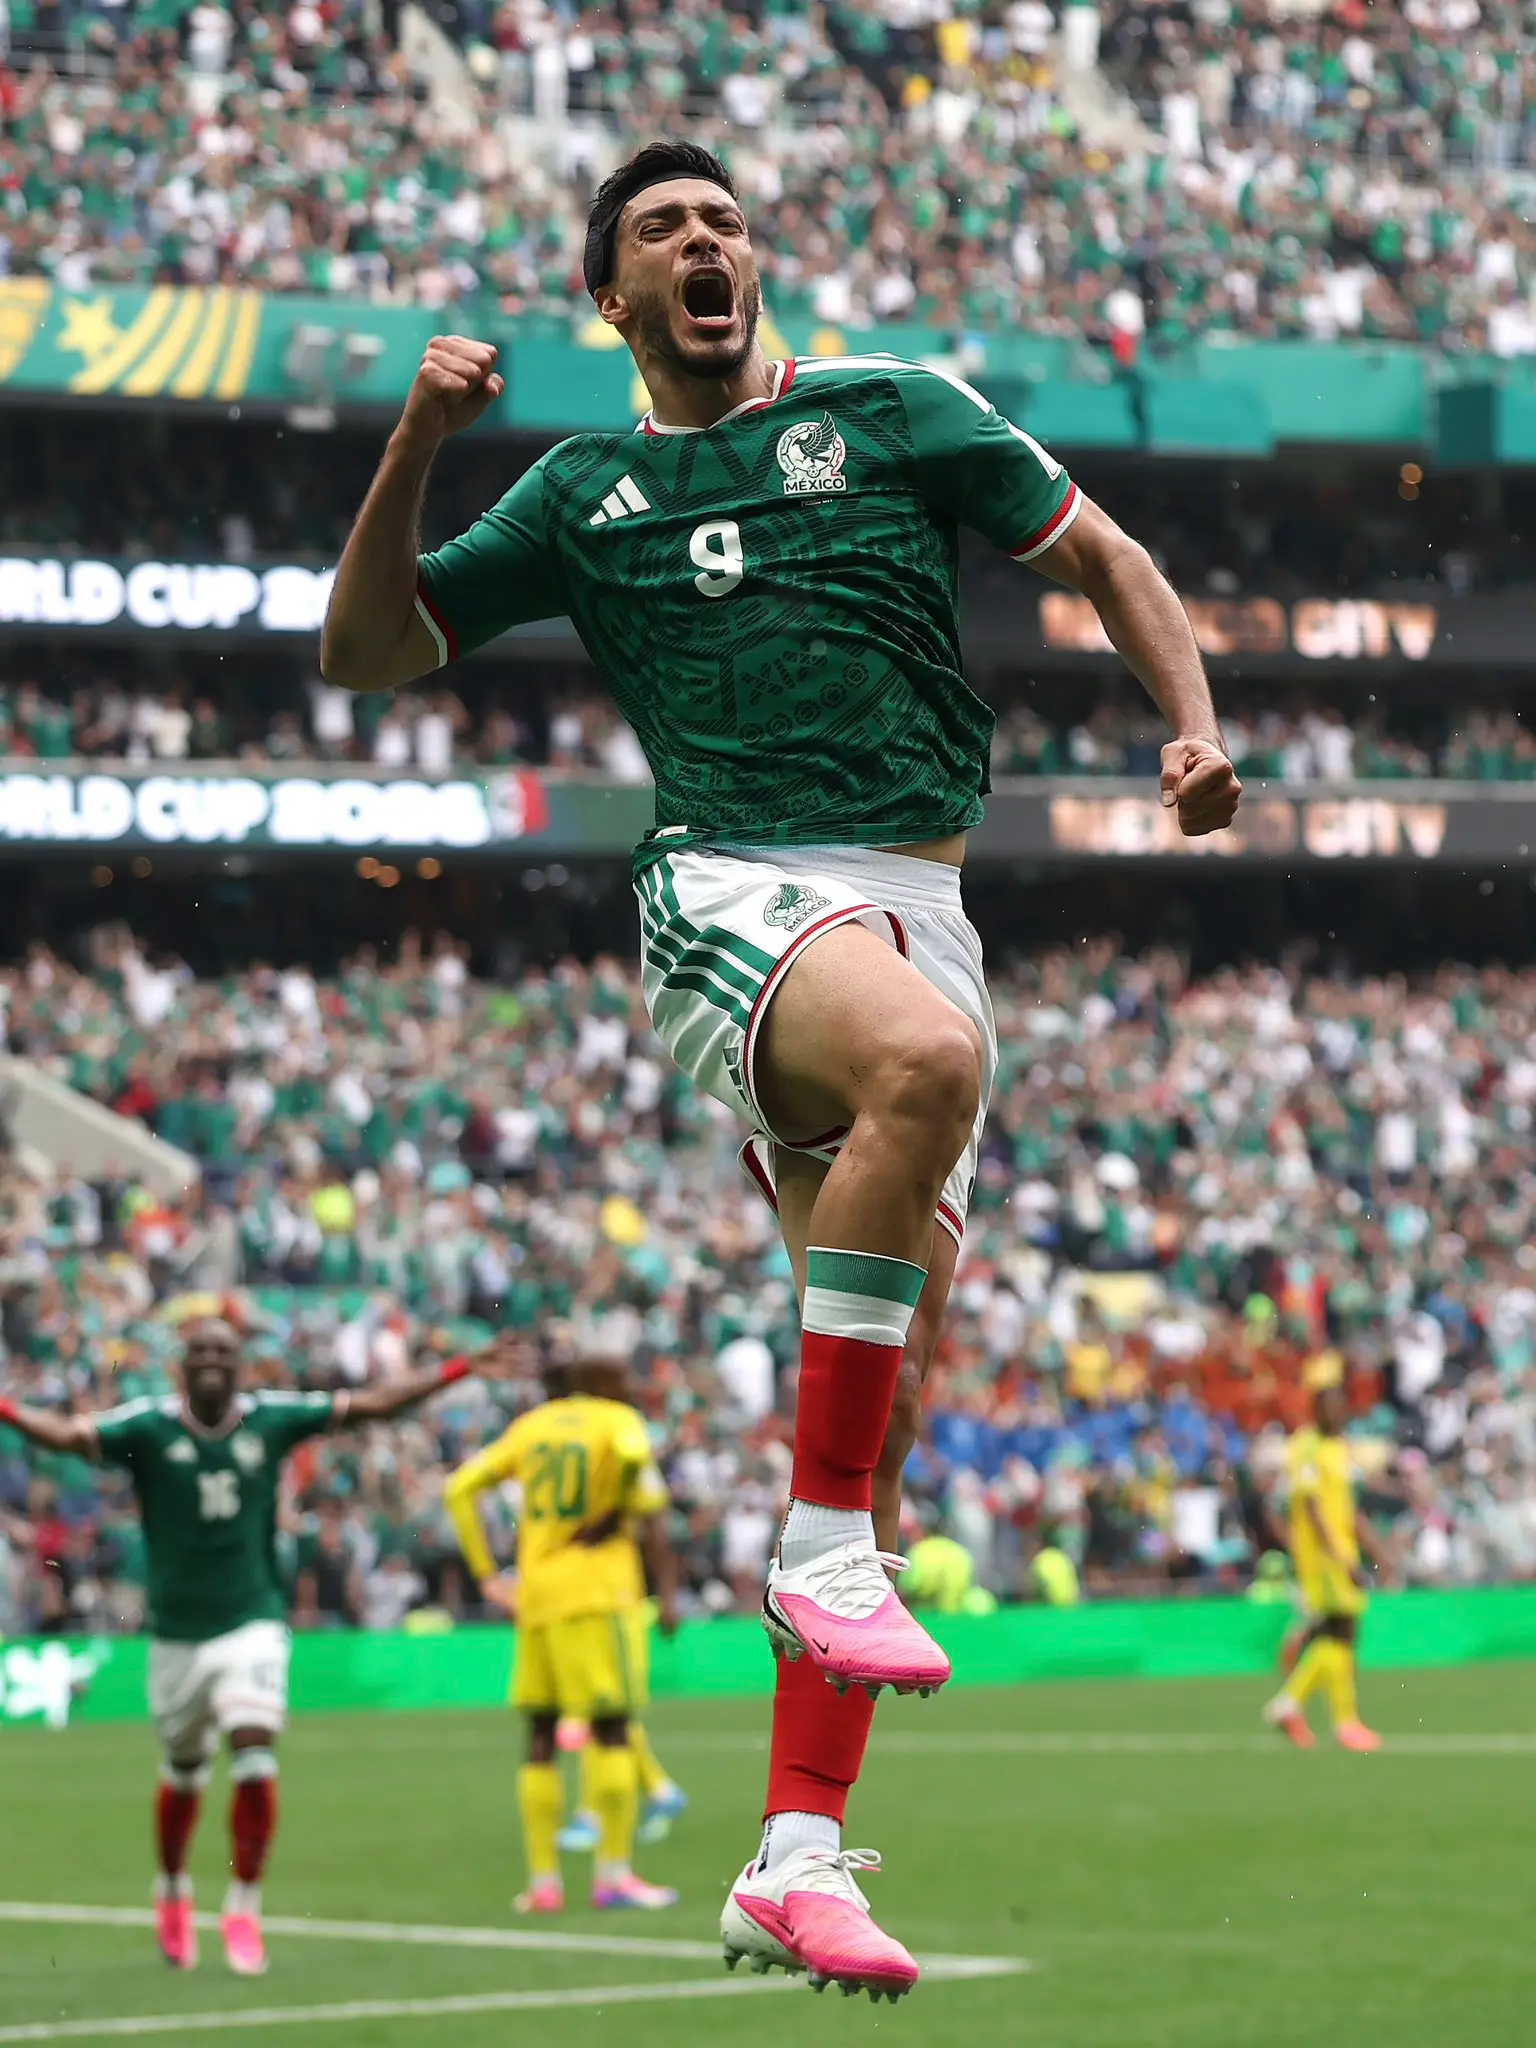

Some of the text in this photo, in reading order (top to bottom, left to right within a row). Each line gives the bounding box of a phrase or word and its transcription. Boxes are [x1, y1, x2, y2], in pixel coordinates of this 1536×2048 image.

[785, 478, 844, 492] MÉXICO
[689, 519, 743, 597] 9
[127, 562, 261, 629] CUP
[0, 775, 134, 839] RLD
[136, 776, 266, 842] CUP
[525, 1441, 588, 1518] 20
